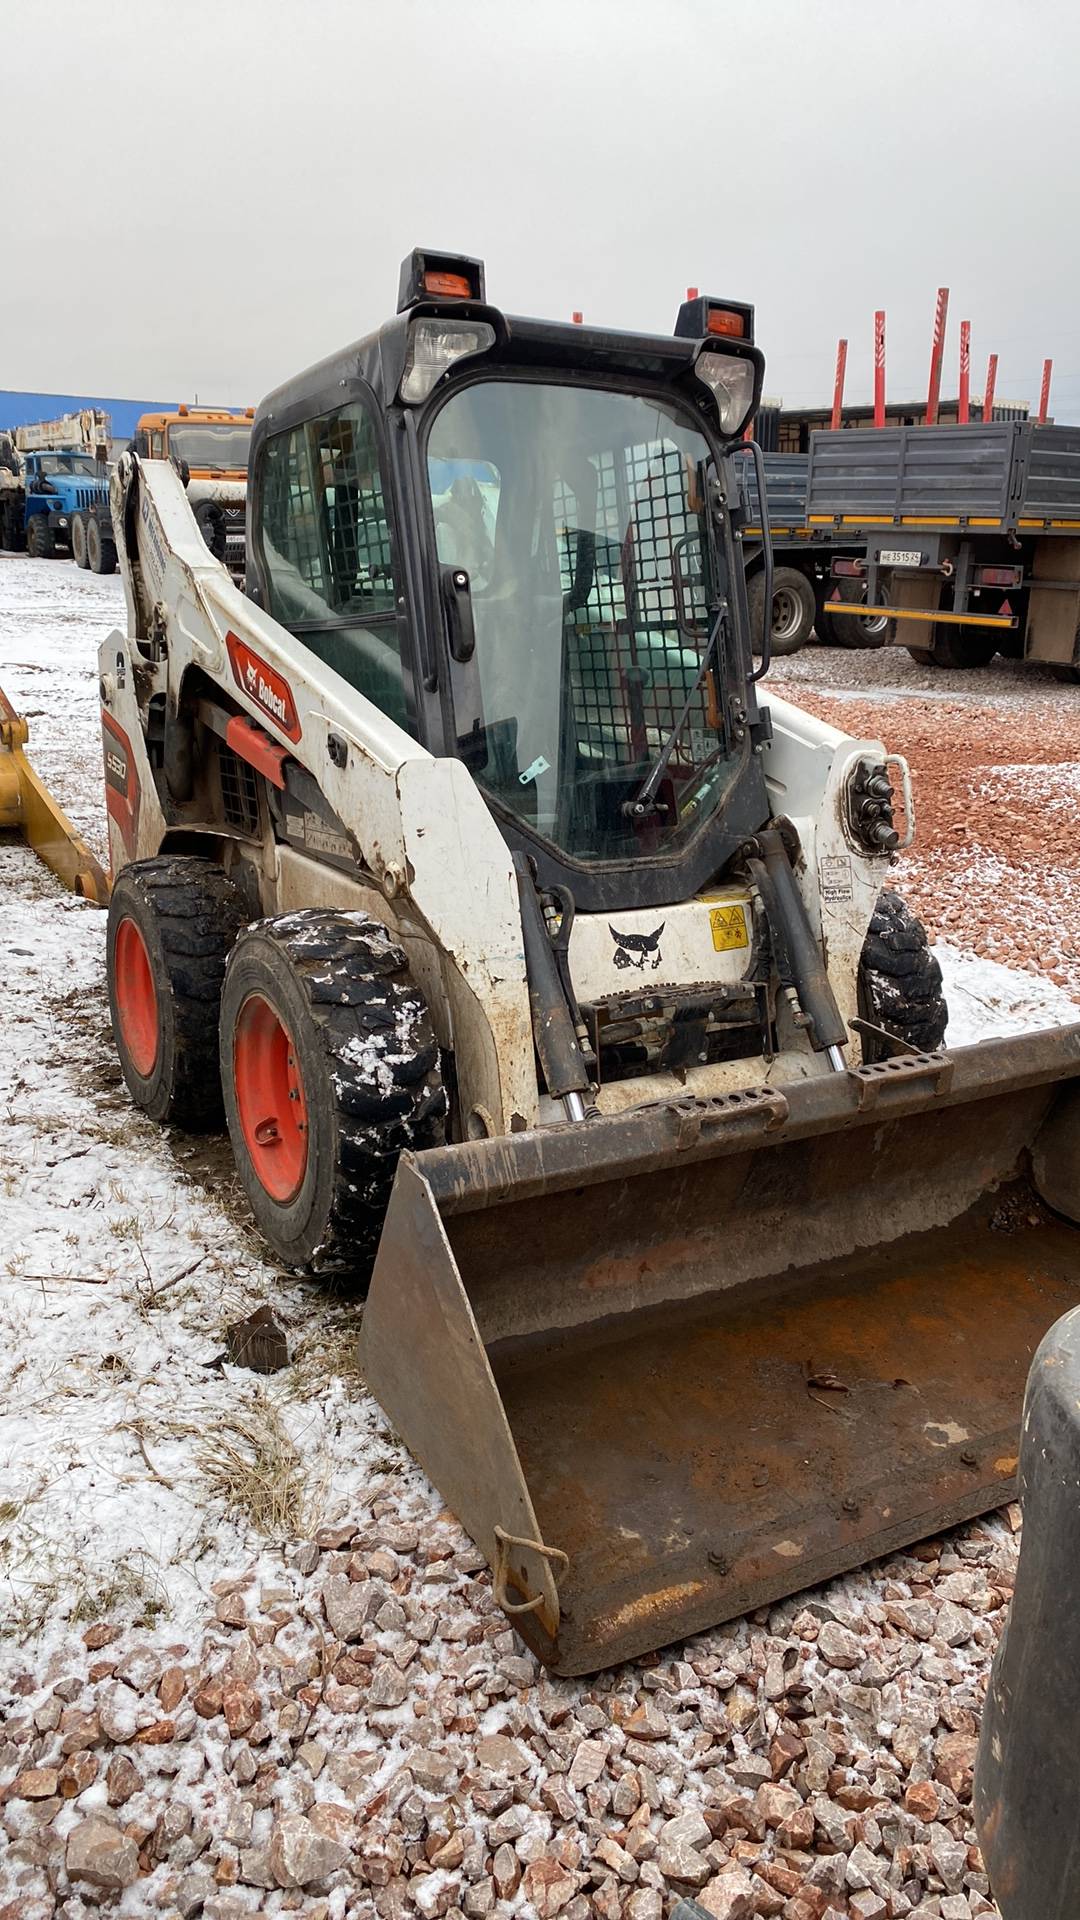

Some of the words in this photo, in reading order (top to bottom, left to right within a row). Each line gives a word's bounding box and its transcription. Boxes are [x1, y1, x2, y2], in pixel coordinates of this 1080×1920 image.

[892, 552, 910, 562] 3515
[258, 676, 286, 722] Bobcat
[106, 752, 126, 779] S530
